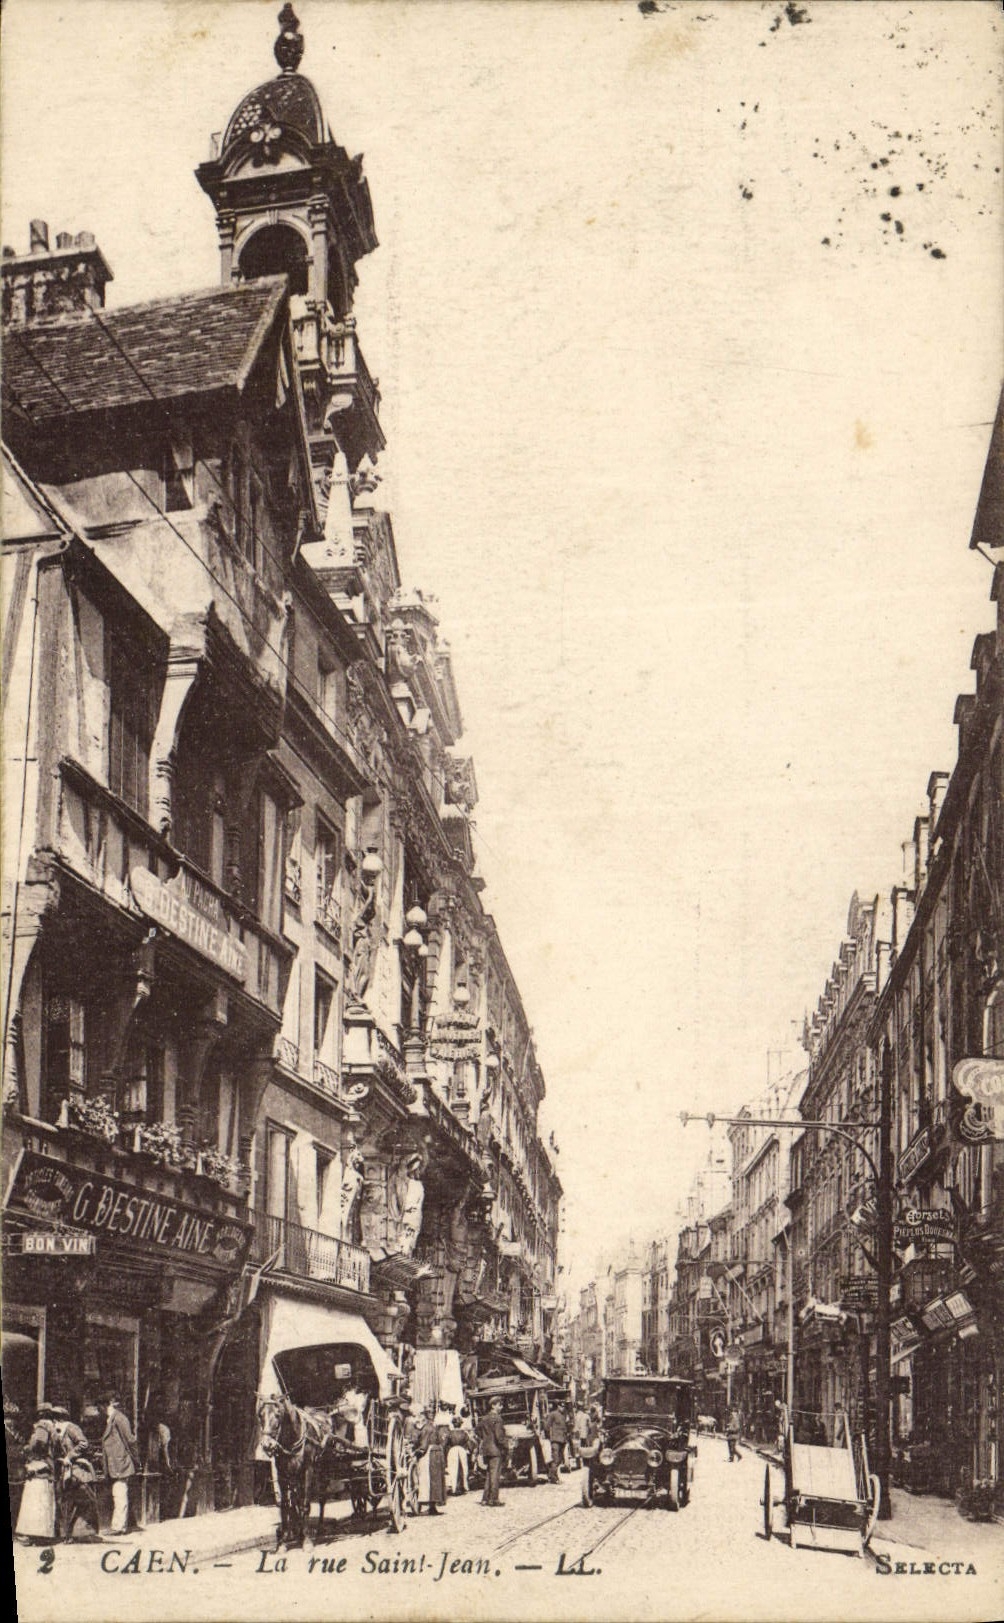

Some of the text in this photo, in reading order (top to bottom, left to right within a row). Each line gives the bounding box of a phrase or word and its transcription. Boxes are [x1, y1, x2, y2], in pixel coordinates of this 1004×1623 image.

[906, 1209, 950, 1226] Corsets
[25, 1237, 88, 1252] BON VIN
